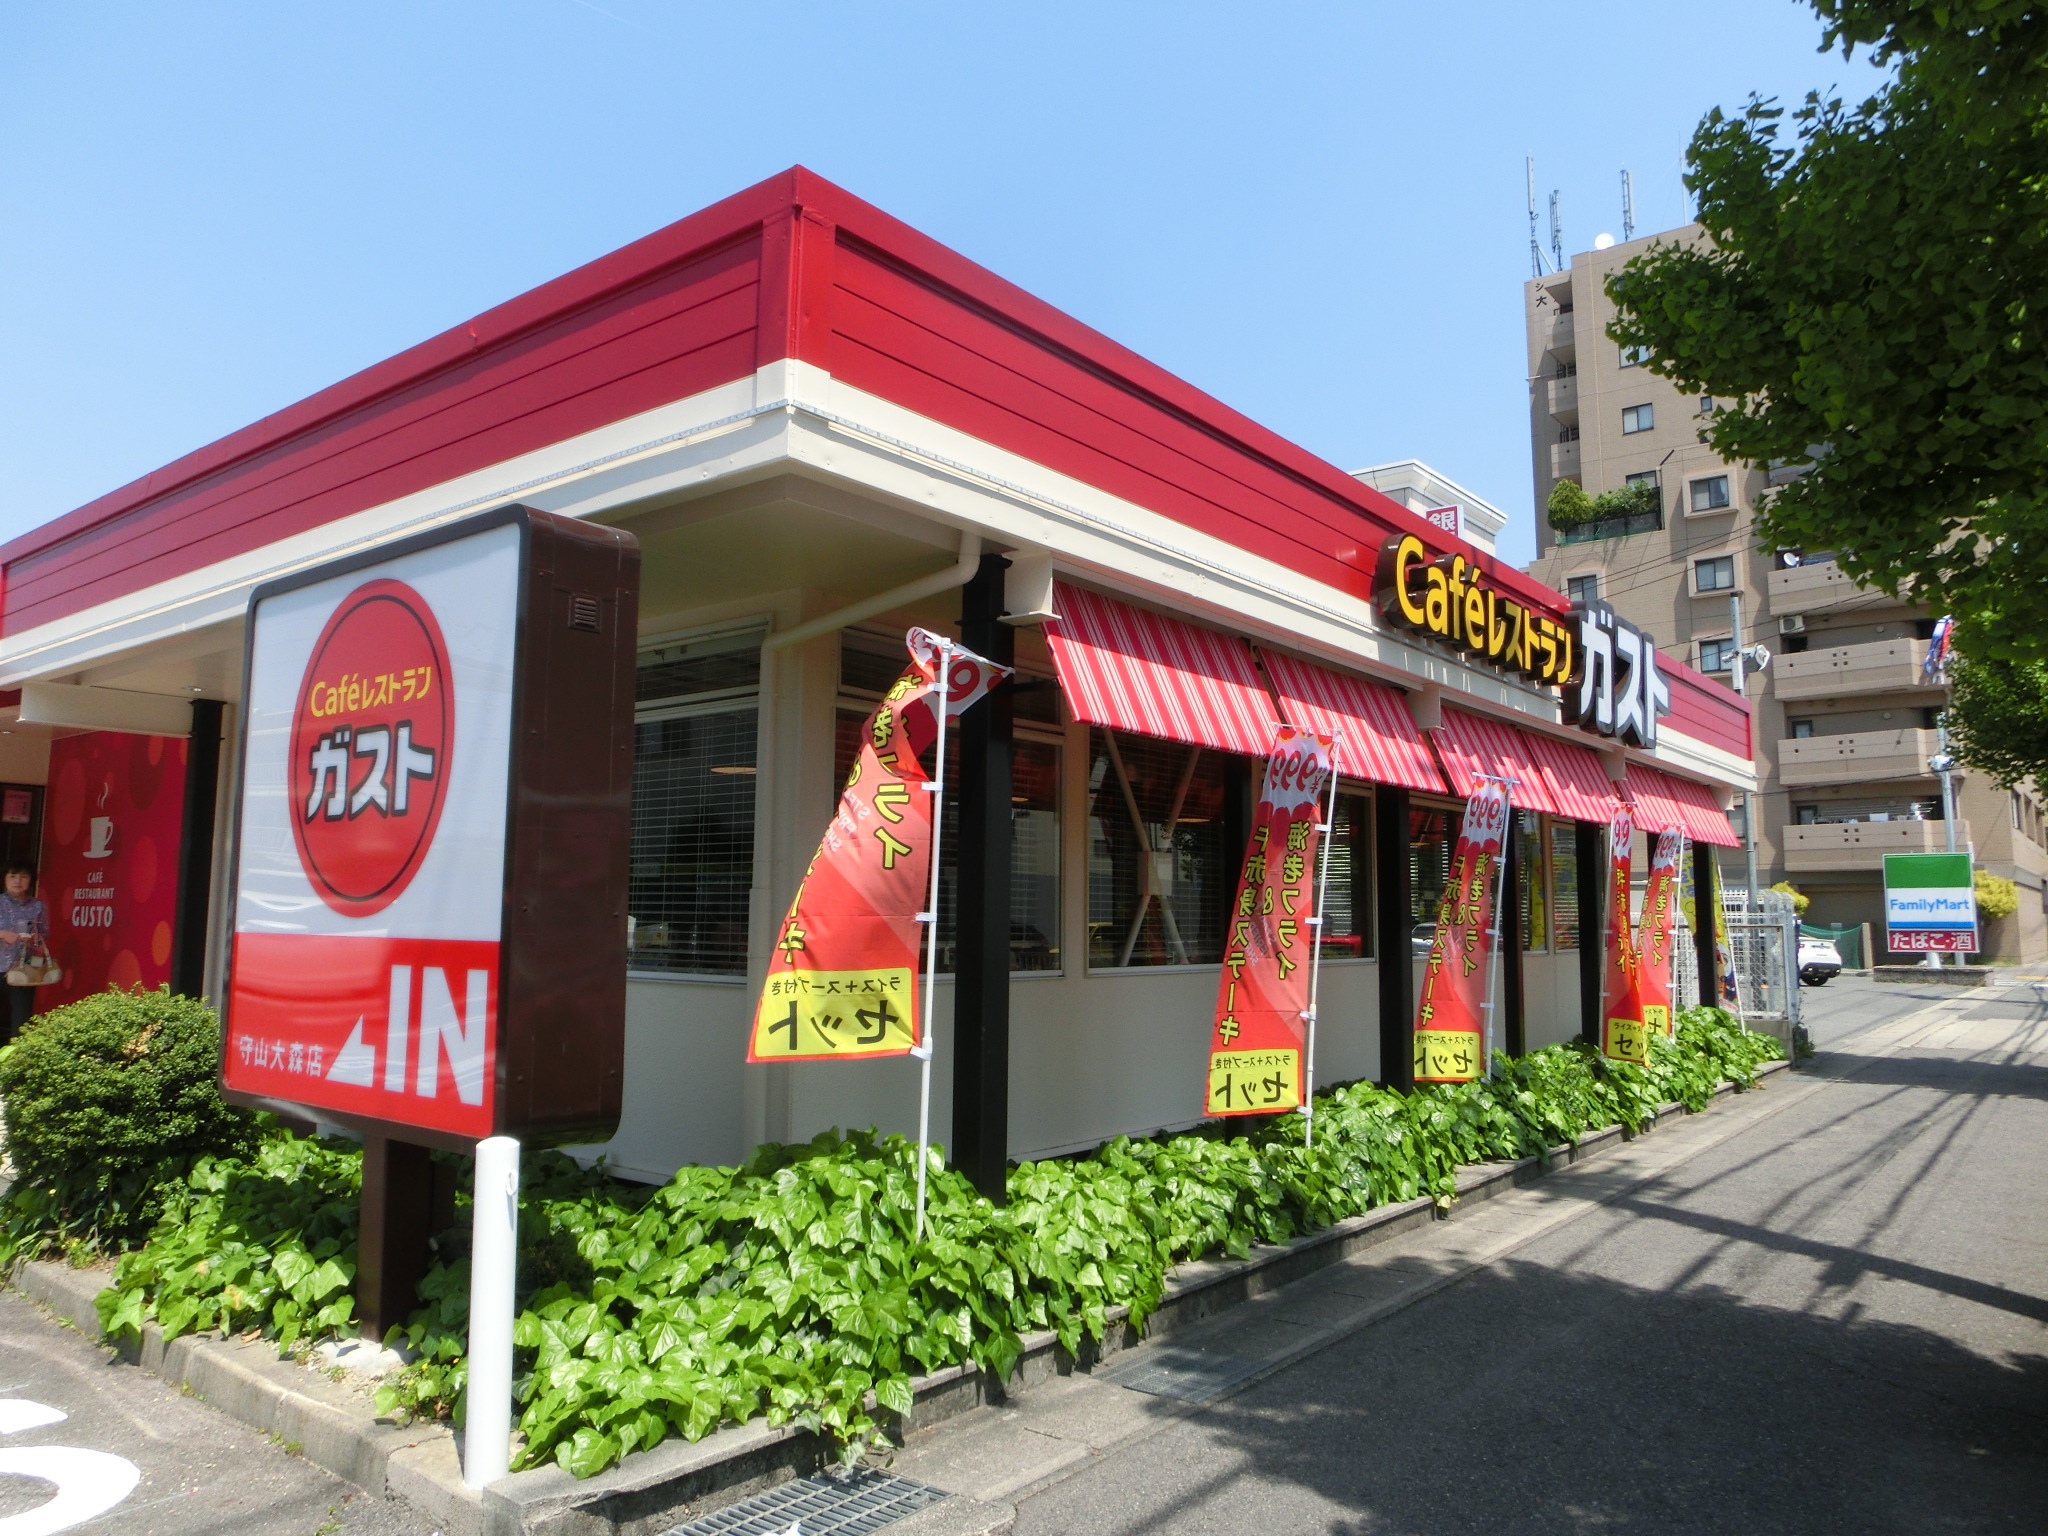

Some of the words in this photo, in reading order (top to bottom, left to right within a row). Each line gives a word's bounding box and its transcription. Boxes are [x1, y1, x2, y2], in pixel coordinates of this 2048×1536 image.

[310, 666, 432, 718] Caféレストラン
[1579, 603, 1670, 745] ガスト
[305, 719, 436, 825] ガスト
[72, 905, 113, 927] GUSTO
[74, 887, 115, 899] RESTAURANT
[1890, 899, 1970, 913] FamilyMart
[239, 1034, 324, 1077] 守山大森店
[384, 964, 489, 1107] IN
